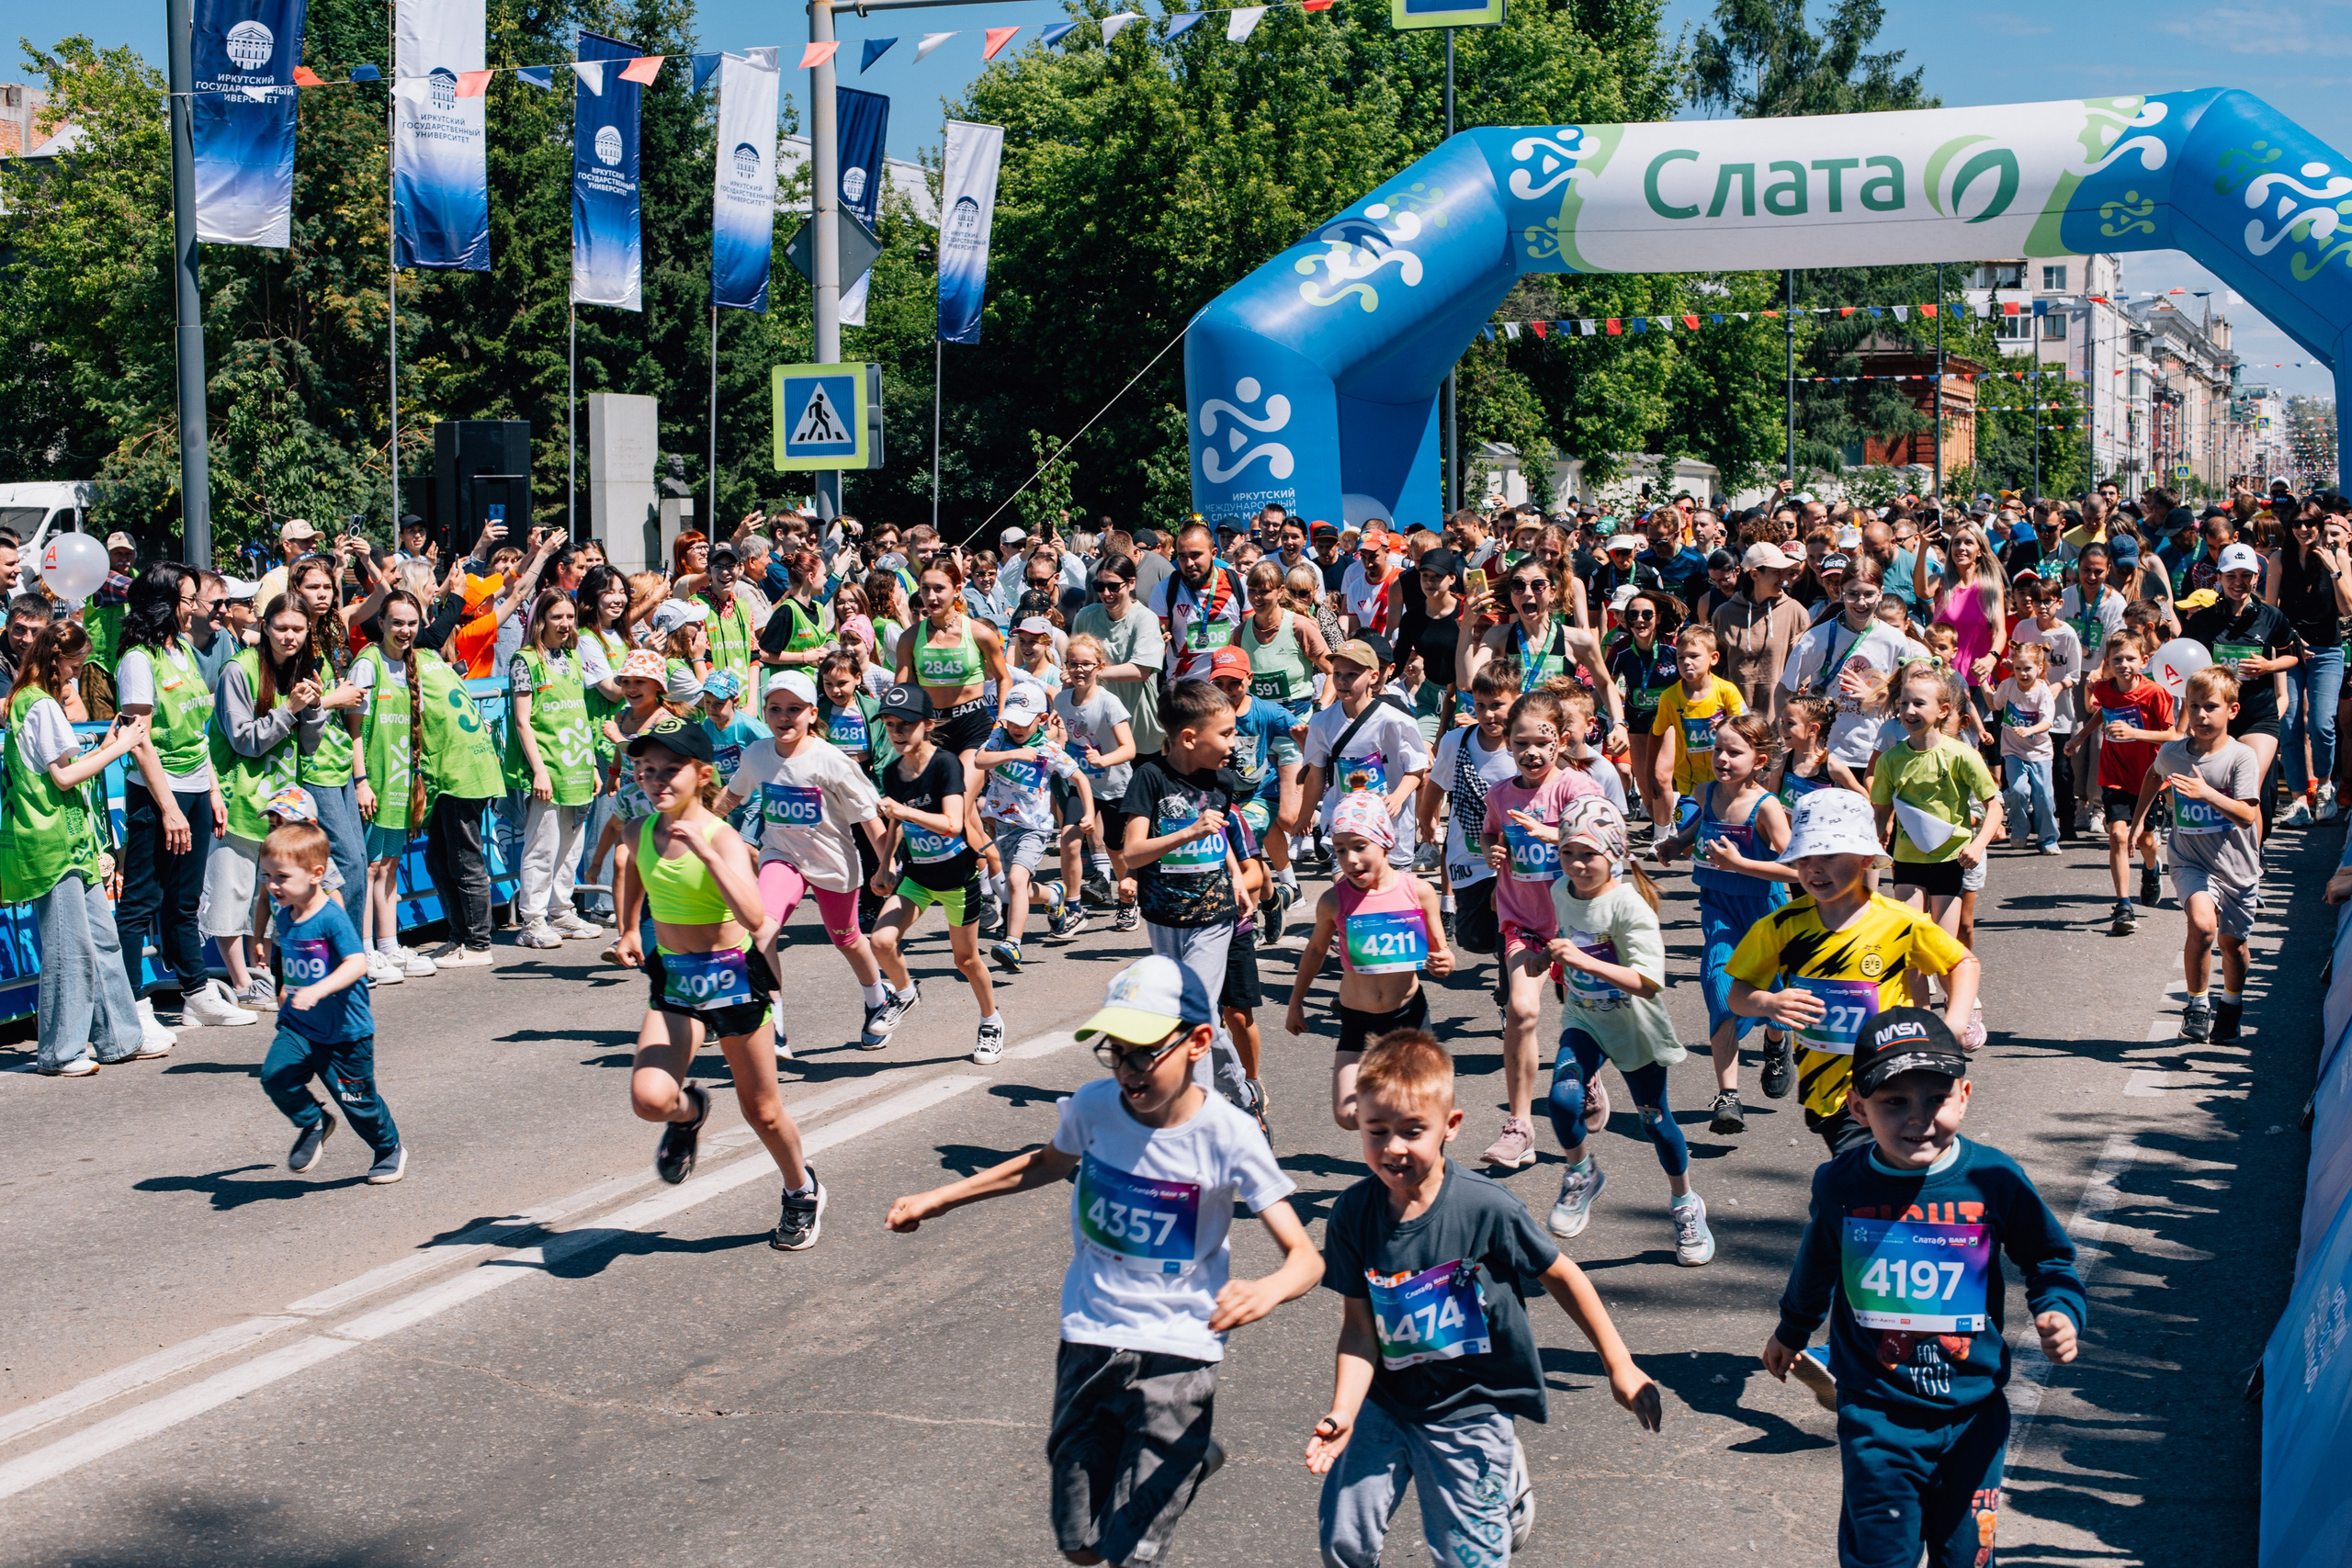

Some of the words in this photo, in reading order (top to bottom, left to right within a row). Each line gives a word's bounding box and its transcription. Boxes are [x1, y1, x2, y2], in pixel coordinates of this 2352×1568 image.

[218, 73, 275, 85] ИРКУТСКИЙ
[196, 81, 294, 96] ГОСУДАРНЫЙ
[421, 114, 466, 126] ИРКУТСКИЙ
[402, 121, 481, 137] ГОСУДАРСТВЕННЫЙ
[415, 131, 469, 143] УНИВЕРСИТЕТ
[578, 172, 636, 191] ГОСУДАРСТВЕННЫЙ
[592, 166, 625, 180] ИРКУТСКИЙ
[588, 182, 628, 197] УНИВЕРСИТЕТ
[1644, 149, 1905, 220] Слата
[1233, 488, 1295, 502] ИРКУТСКИЙ
[1191, 631, 1227, 644] 208
[923, 660, 964, 674] 2843
[1255, 682, 1281, 696] 591
[542, 699, 586, 712] ВОЛОНТ
[830, 727, 865, 740] 4281
[714, 755, 741, 772] 295
[1002, 761, 1036, 782] 4172
[765, 799, 817, 819] 4005
[1362, 931, 1416, 956] 4211
[675, 969, 737, 998] 4019
[1810, 1006, 1866, 1033] 227
[1875, 1021, 1928, 1045] NASA
[1088, 1197, 1178, 1246] 4357
[1860, 1258, 1965, 1301] 4197
[1374, 1295, 1466, 1346] 4474
[1917, 1344, 1940, 1364] FOR
[1909, 1363, 1951, 1396] YOU
